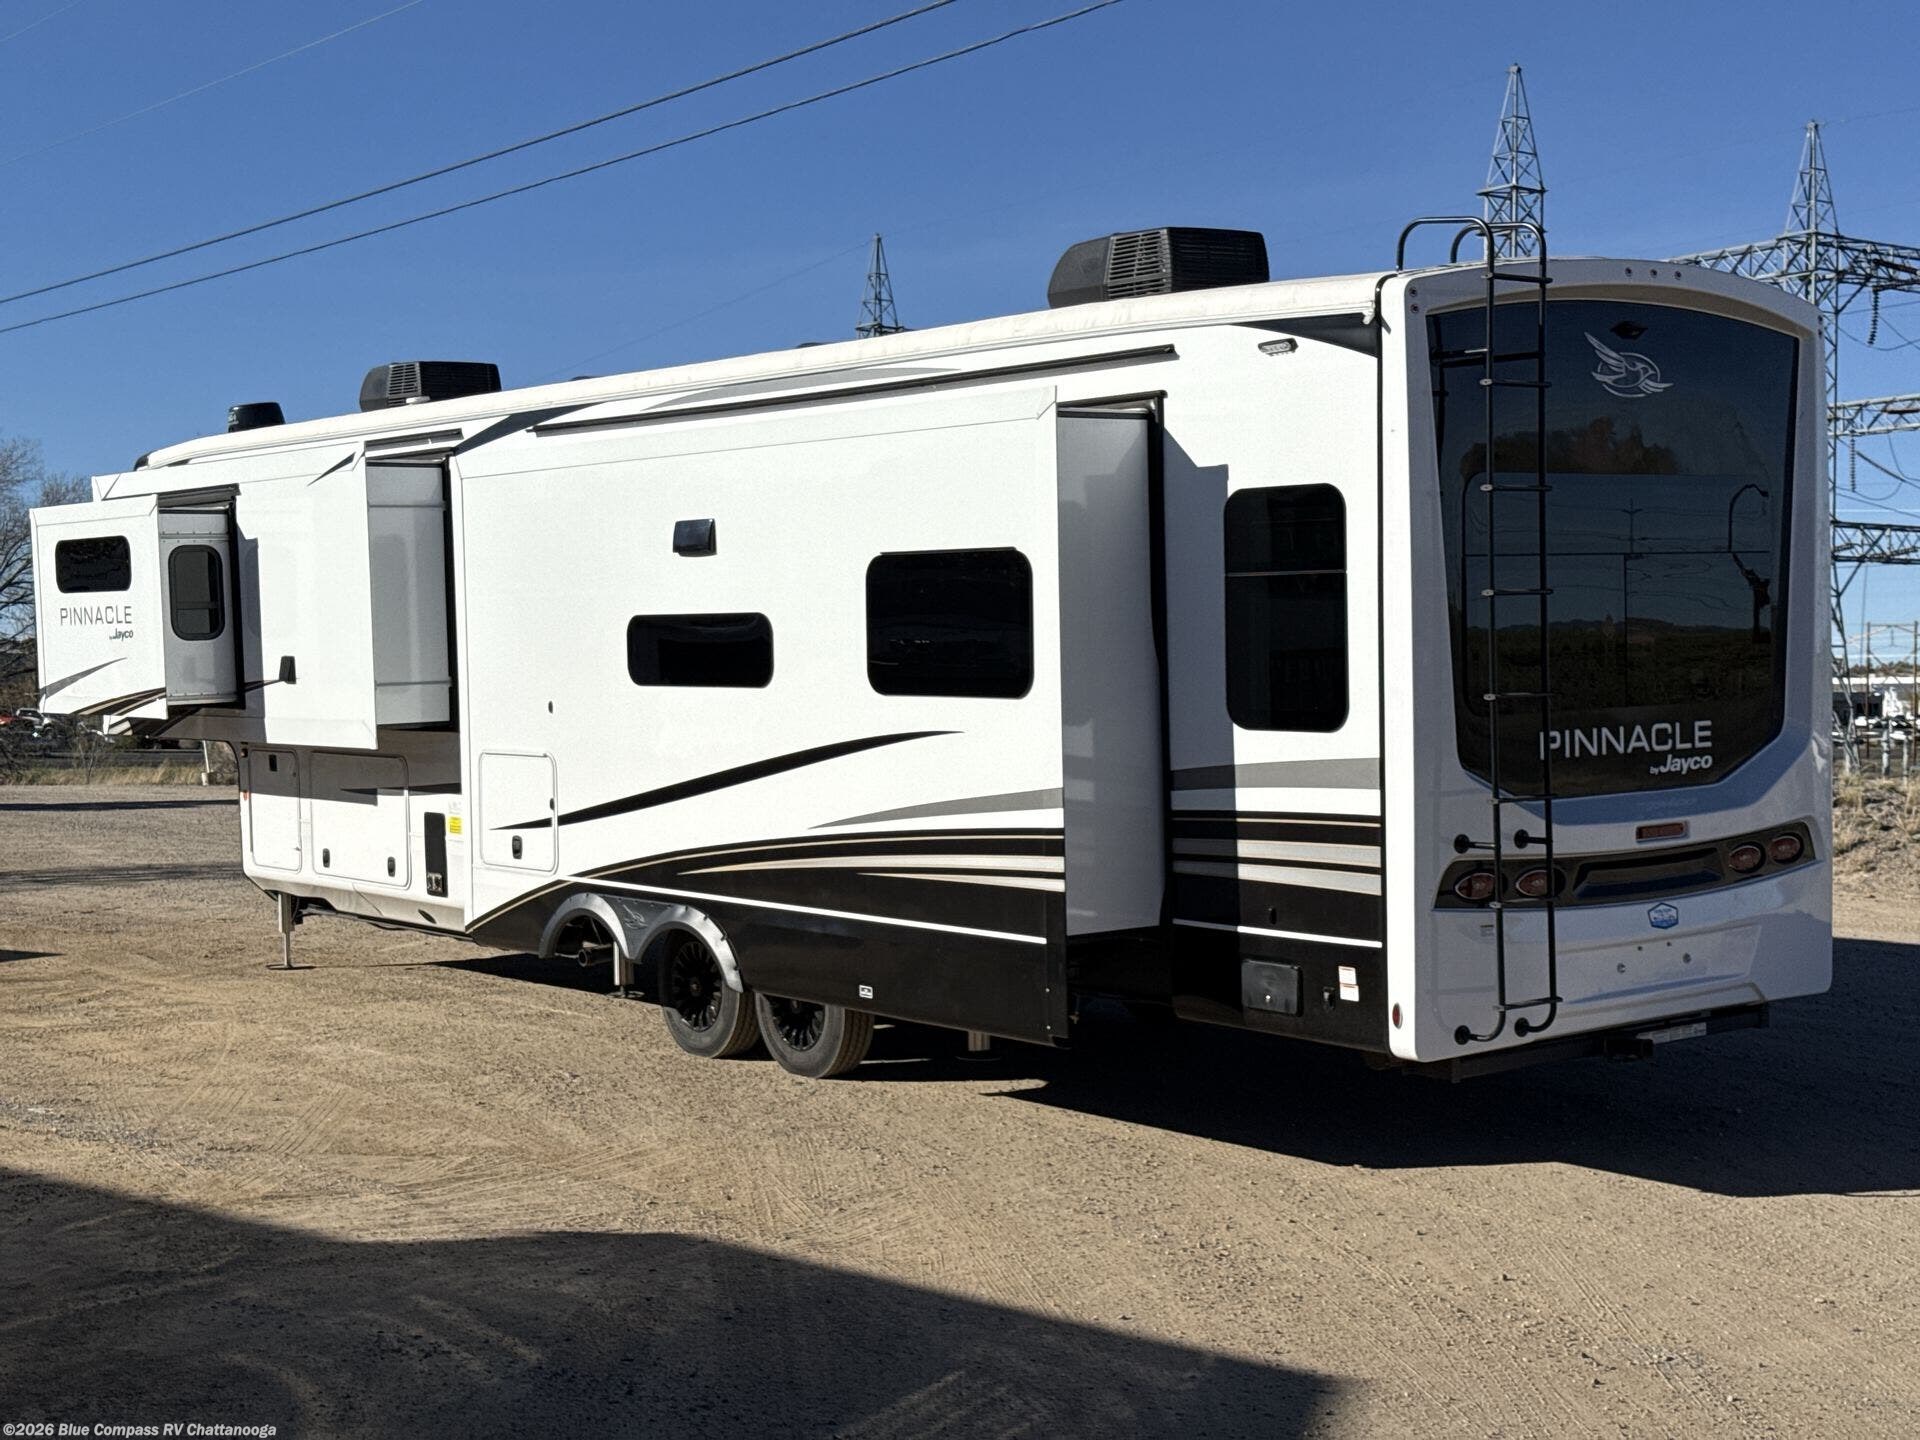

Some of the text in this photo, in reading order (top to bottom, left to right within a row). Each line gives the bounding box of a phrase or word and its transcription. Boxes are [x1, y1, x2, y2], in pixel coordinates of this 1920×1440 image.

[60, 605, 132, 626] PINNACLE
[113, 628, 133, 641] Jayco
[1539, 720, 1712, 761] PINNACLE
[1649, 754, 1713, 775] by Jayco
